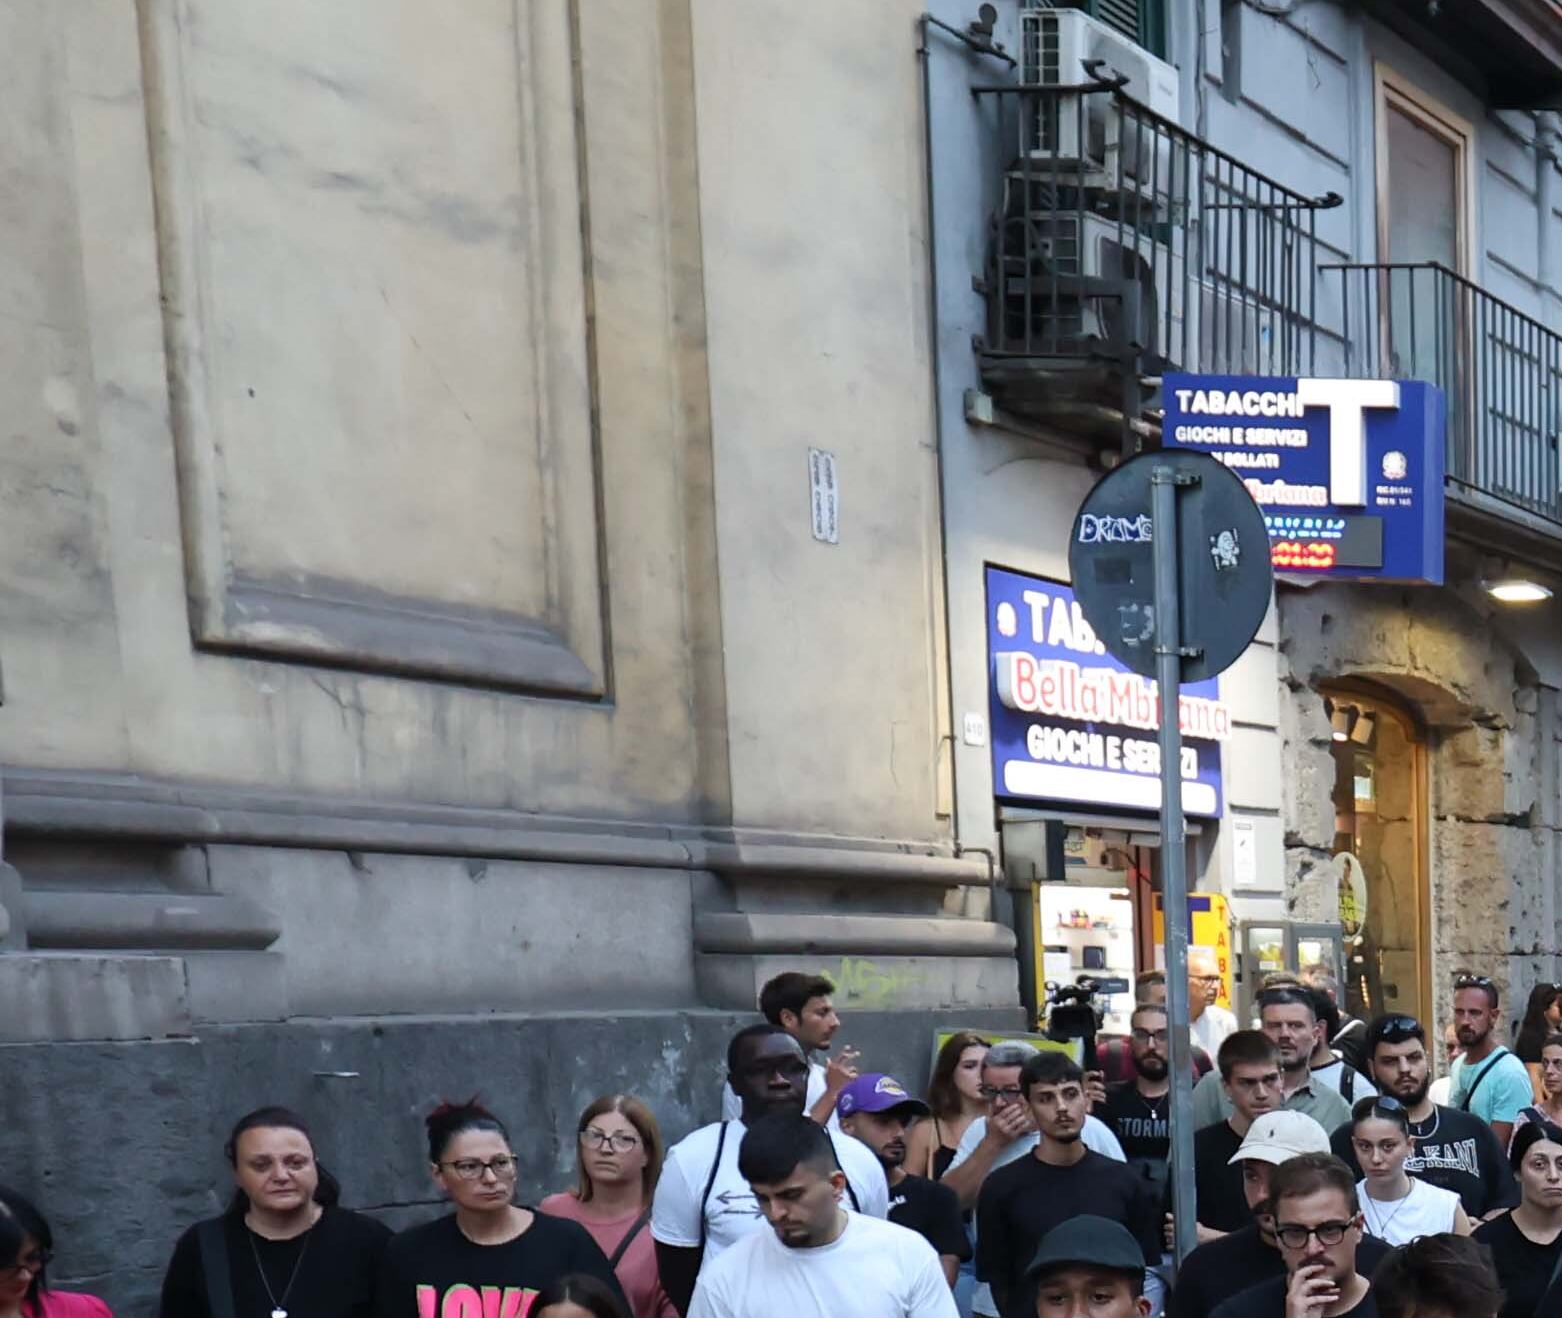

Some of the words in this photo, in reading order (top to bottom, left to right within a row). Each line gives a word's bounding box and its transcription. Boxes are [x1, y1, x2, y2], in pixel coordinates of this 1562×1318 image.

[1175, 390, 1304, 418] TABACCHI
[1175, 427, 1230, 444] GIOCHI
[1233, 428, 1243, 445] E
[1246, 428, 1308, 447] SERVIZI
[1015, 656, 1099, 713] Bella
[1027, 724, 1103, 767] GIOCHI
[1107, 735, 1120, 769] E
